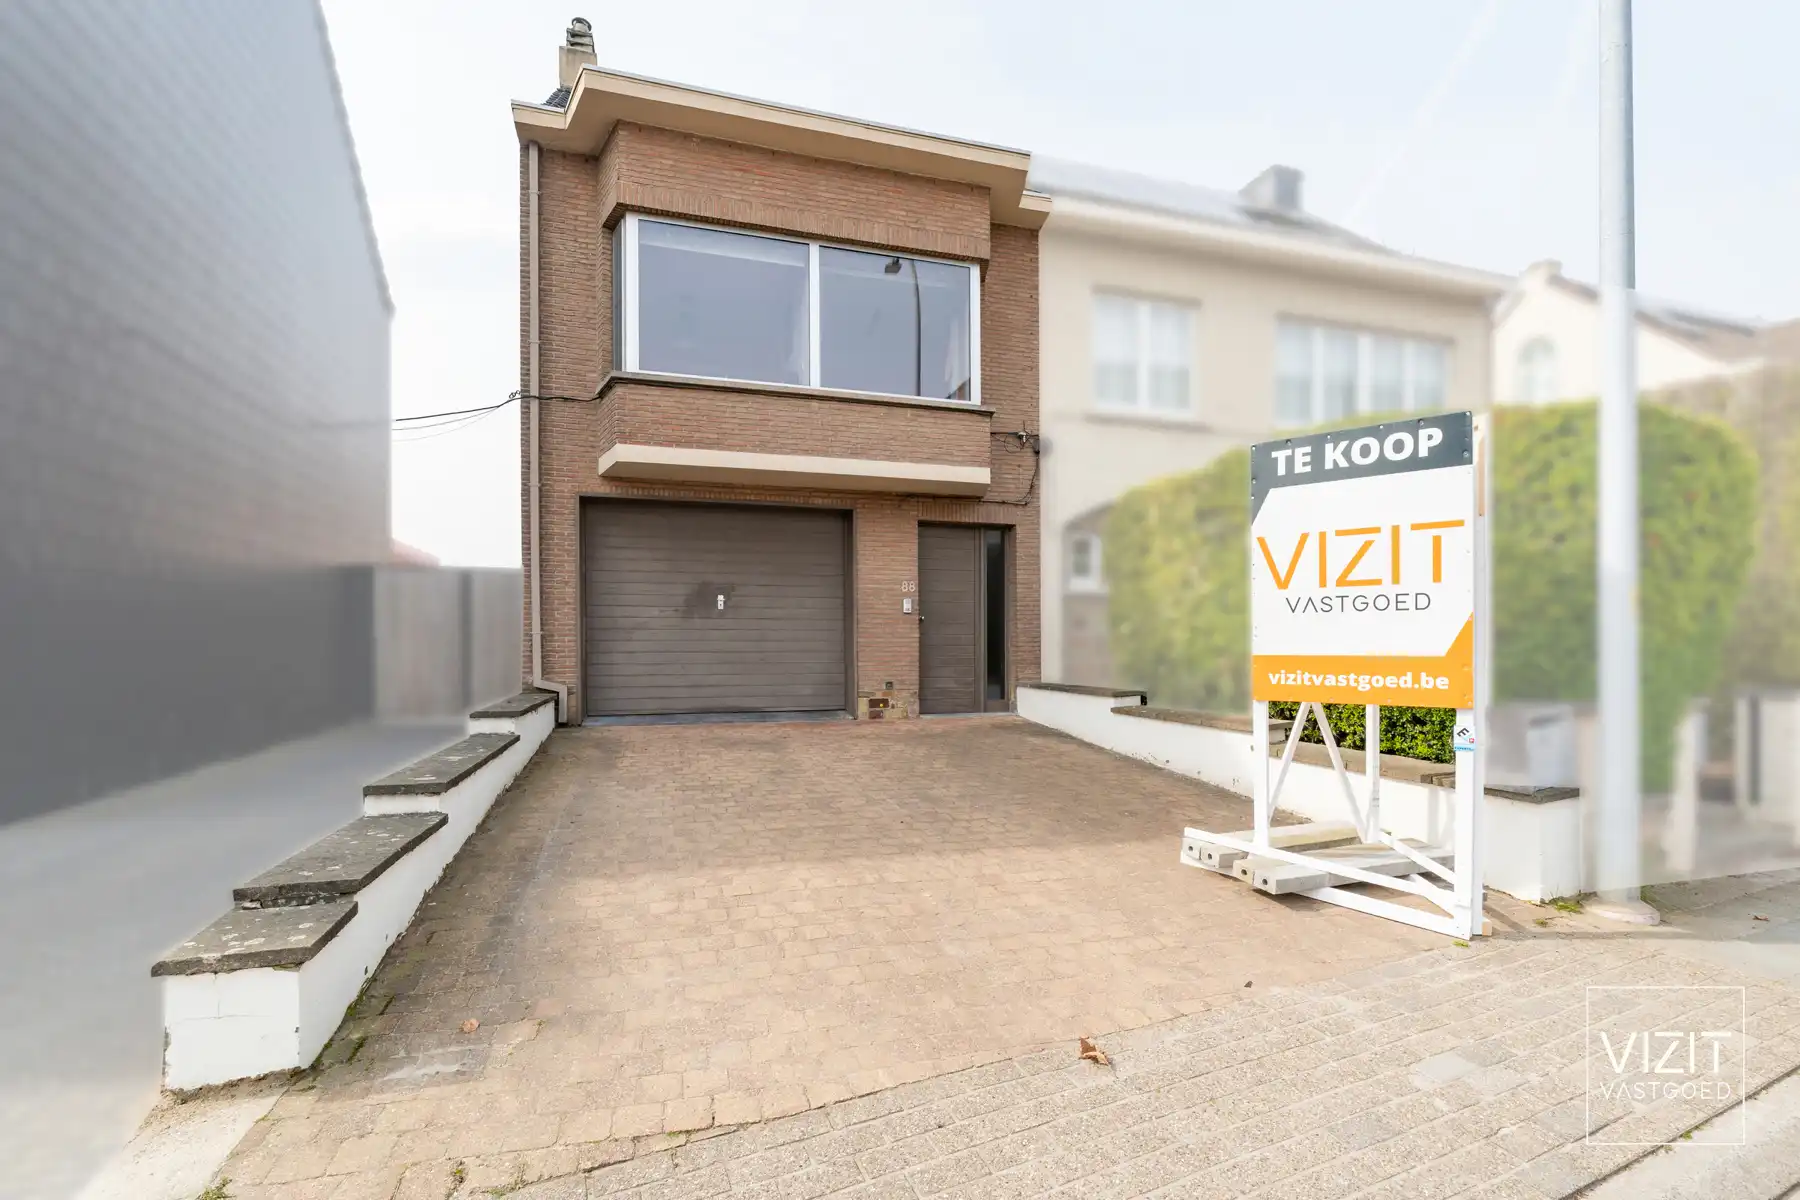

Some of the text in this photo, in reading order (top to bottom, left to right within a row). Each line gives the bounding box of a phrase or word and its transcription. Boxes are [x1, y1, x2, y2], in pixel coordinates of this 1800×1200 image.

[1271, 427, 1443, 476] TE KOOP
[1256, 519, 1465, 590] VIZIT
[901, 580, 916, 592] 88
[1285, 592, 1431, 614] VASTGOED
[1268, 669, 1450, 692] vizitvastgoed.be
